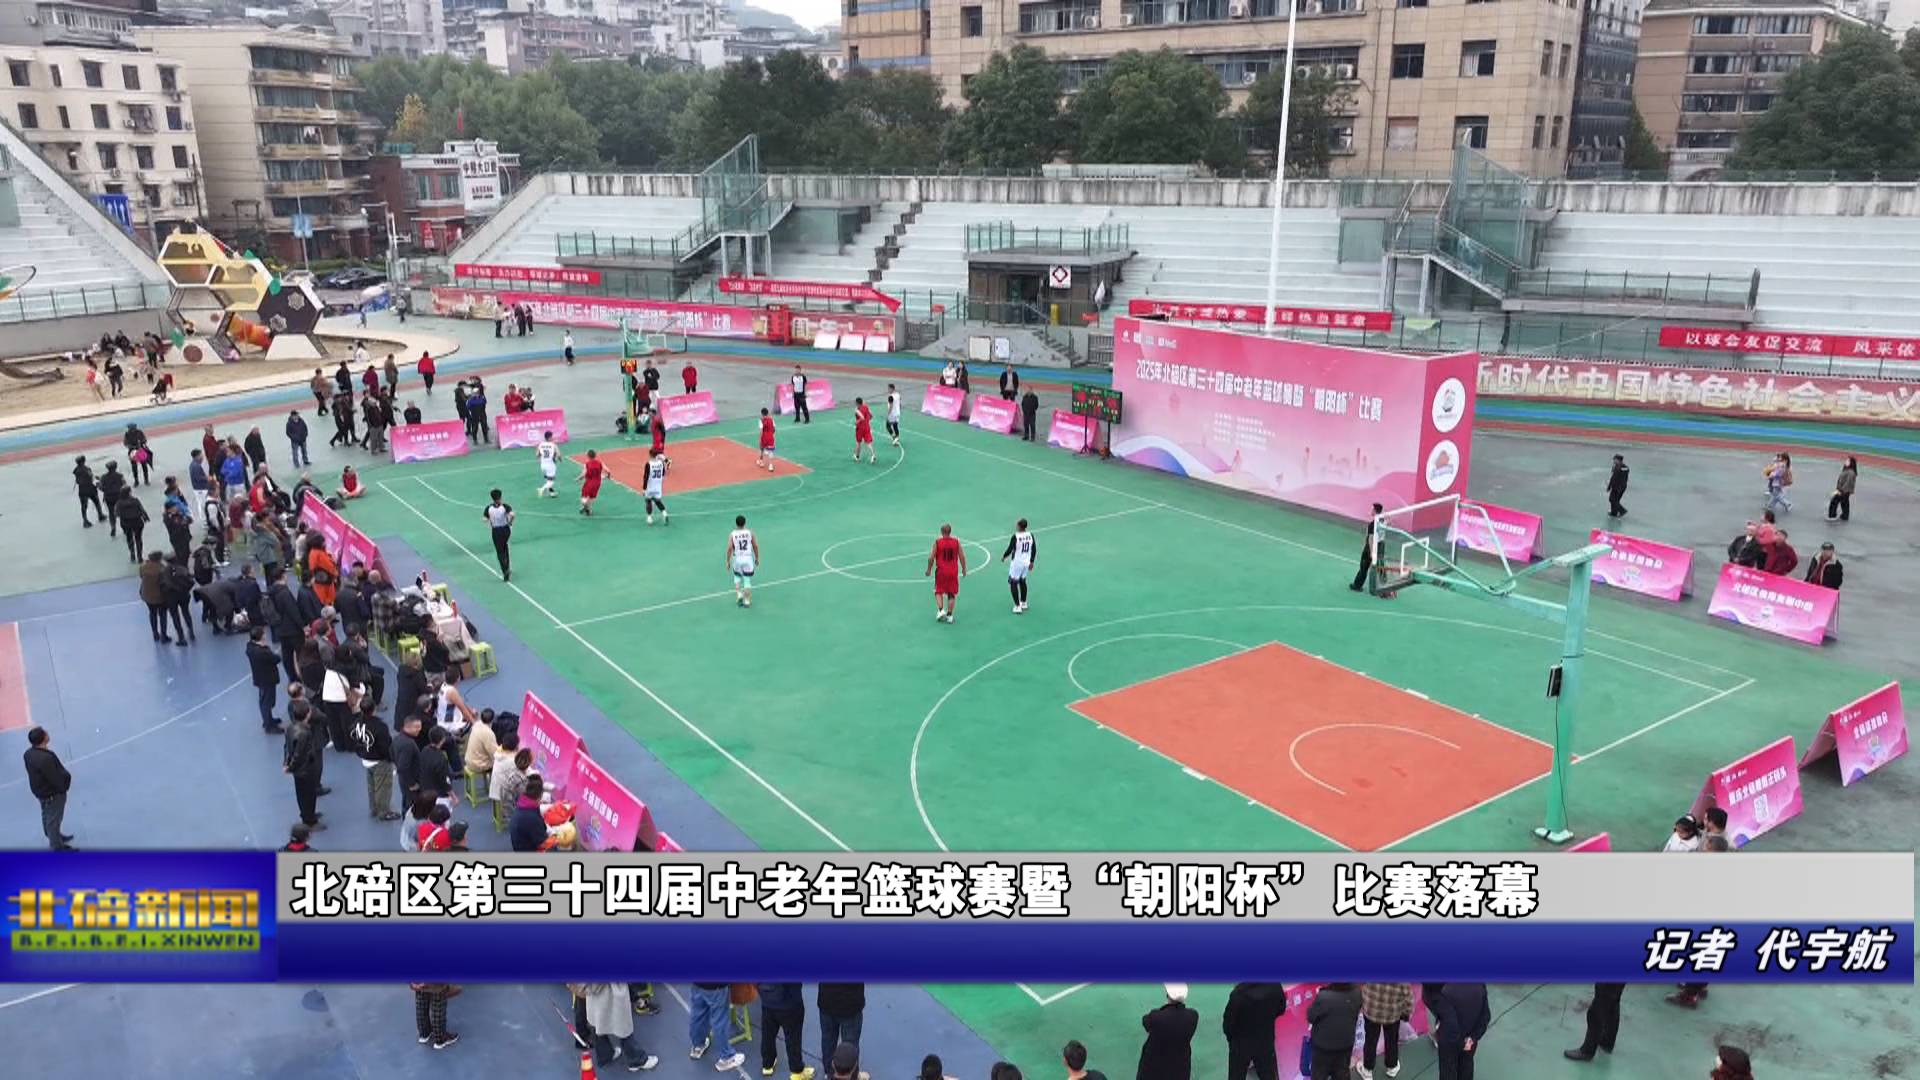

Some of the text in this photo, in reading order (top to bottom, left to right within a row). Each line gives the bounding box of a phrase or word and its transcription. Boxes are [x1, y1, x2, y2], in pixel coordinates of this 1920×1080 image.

[1685, 332, 1915, 357] 以球会友促交流 风采依
[739, 539, 748, 550] 12
